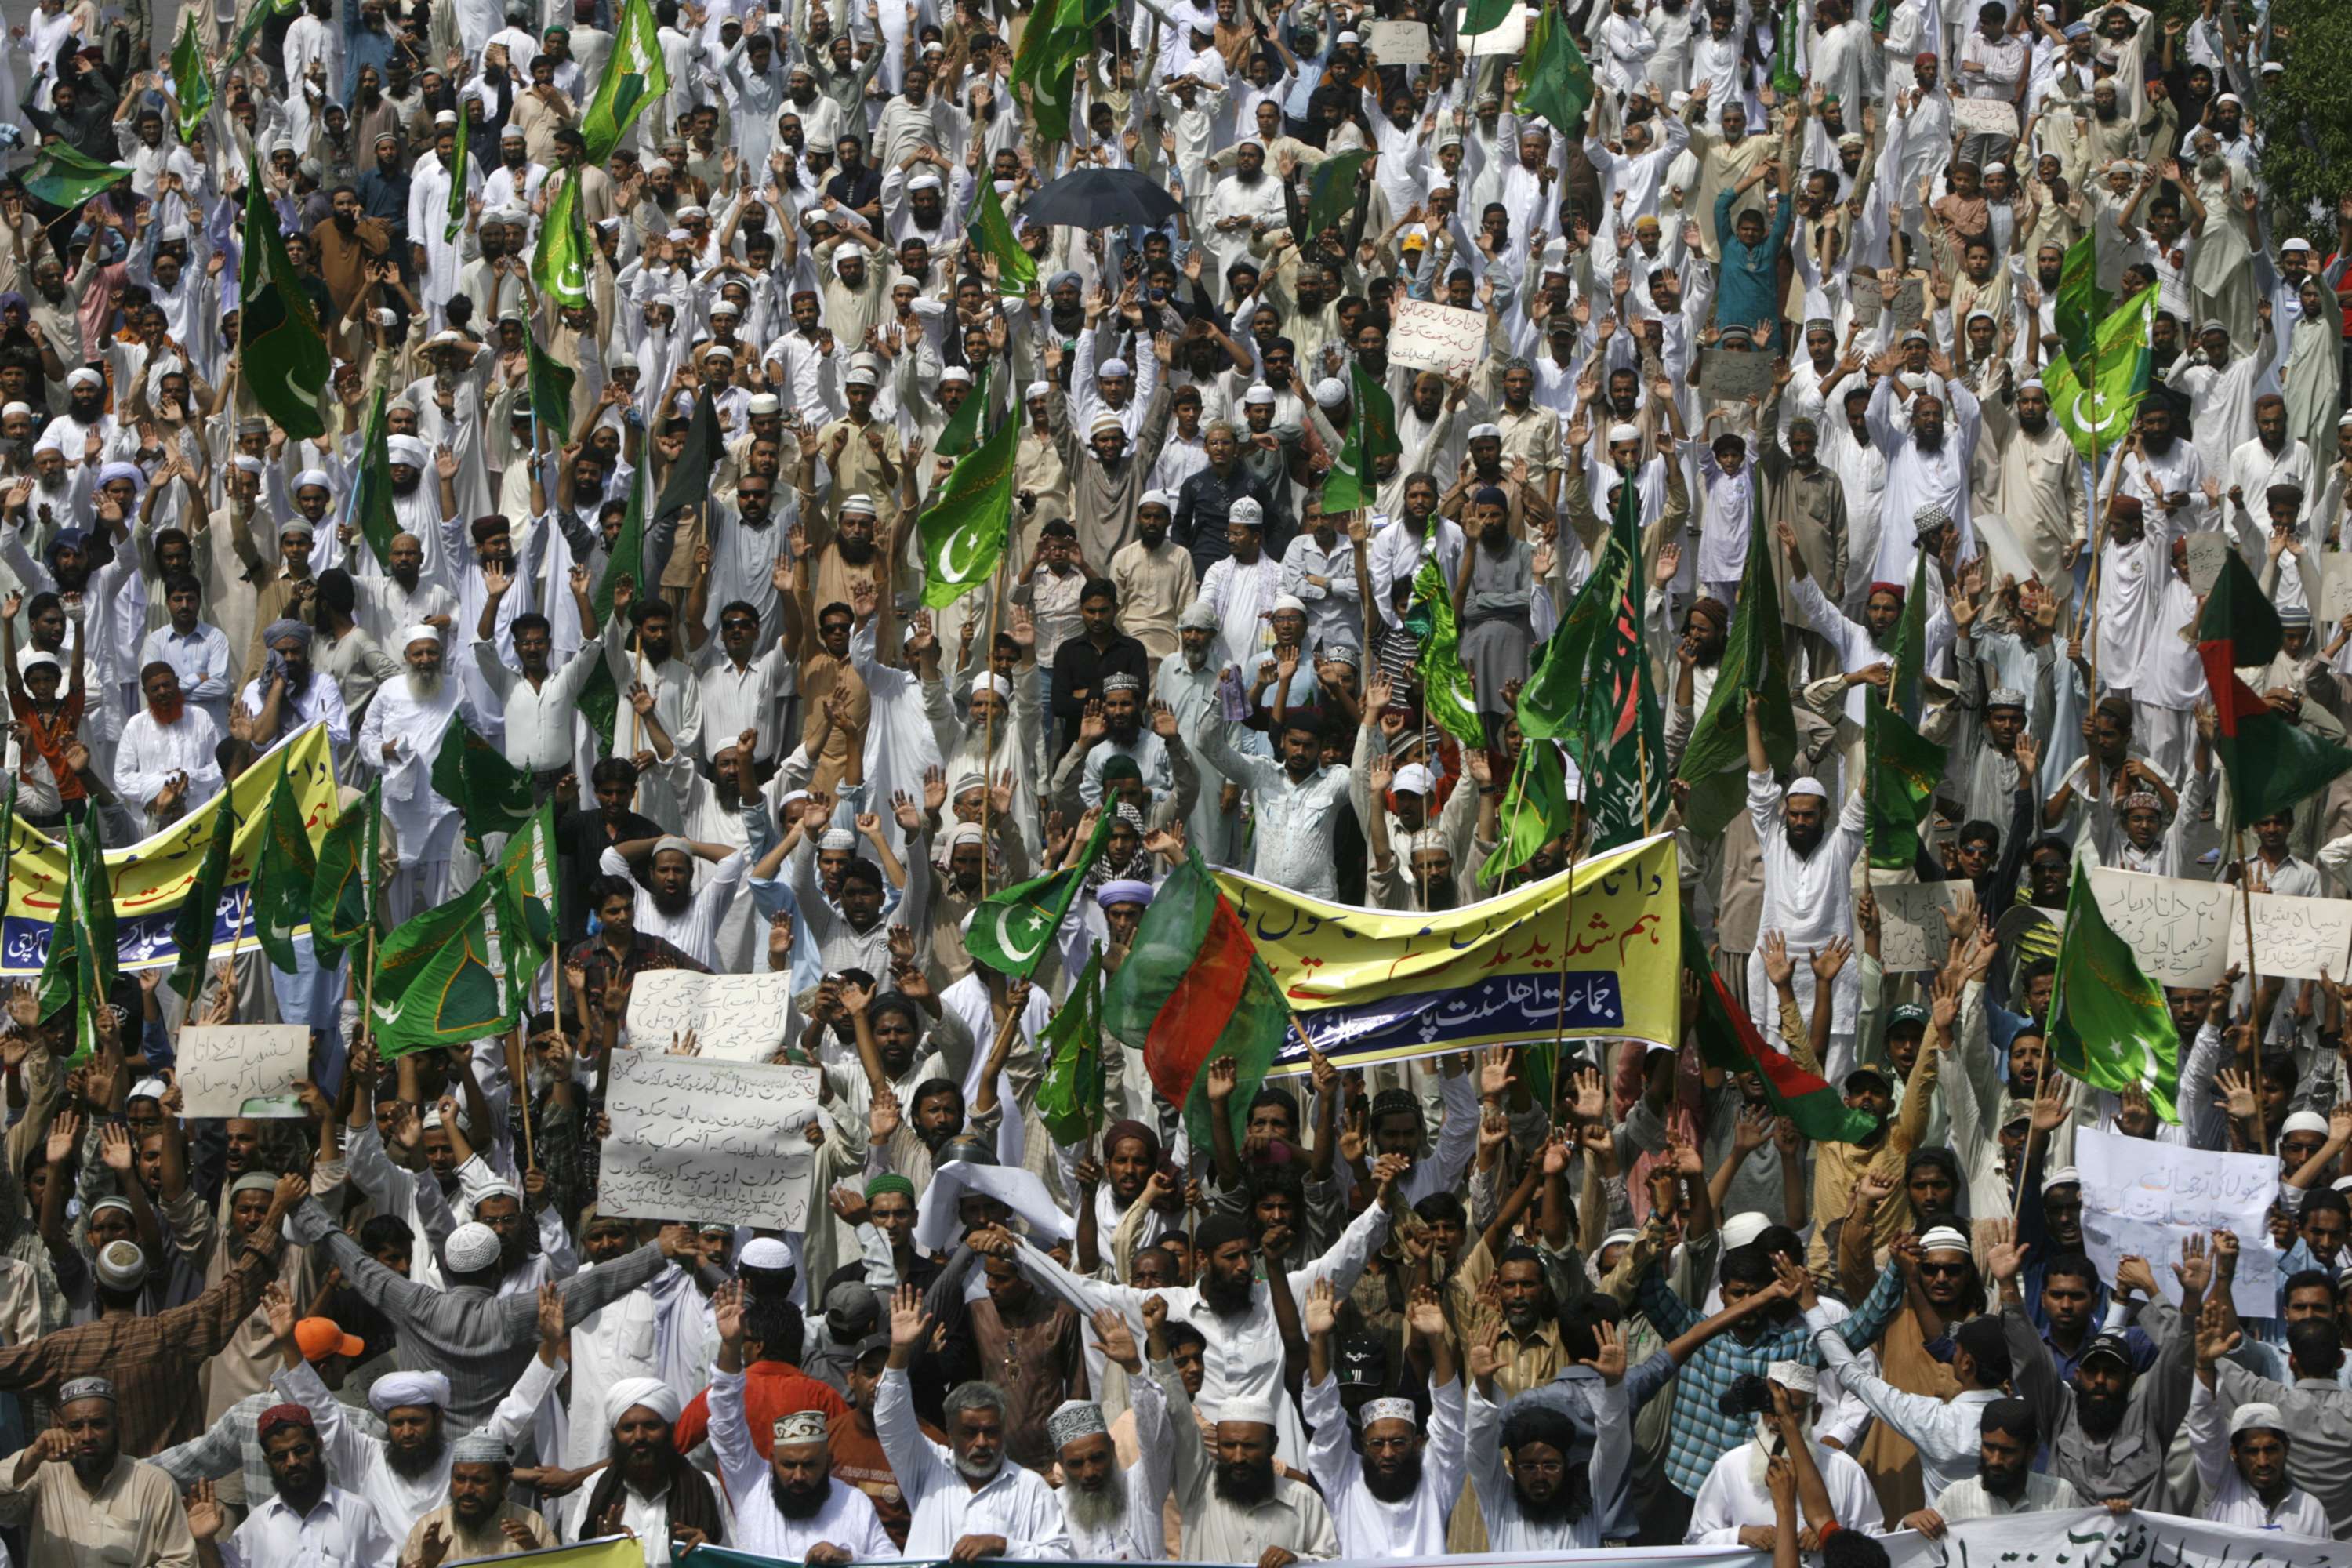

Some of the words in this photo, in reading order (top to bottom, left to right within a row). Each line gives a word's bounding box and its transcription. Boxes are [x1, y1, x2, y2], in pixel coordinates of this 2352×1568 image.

[2107, 879, 2154, 916] دربار
[2154, 881, 2191, 919] داتا
[2196, 891, 2221, 938] ہم
[7, 927, 51, 963] کراچی
[1516, 911, 1617, 969] شدید
[1618, 913, 1661, 967] ہم
[2127, 916, 2153, 945] کی
[2169, 953, 2210, 978] کرتے
[633, 990, 661, 1007] کی
[180, 1066, 229, 1097] سلام
[229, 1066, 254, 1098] کو
[612, 1096, 670, 1117] حکومت
[617, 1122, 655, 1145] تک
[646, 1126, 684, 1152] کب
[672, 1127, 724, 1153] آخر
[2139, 1164, 2213, 1200] ترجمان
